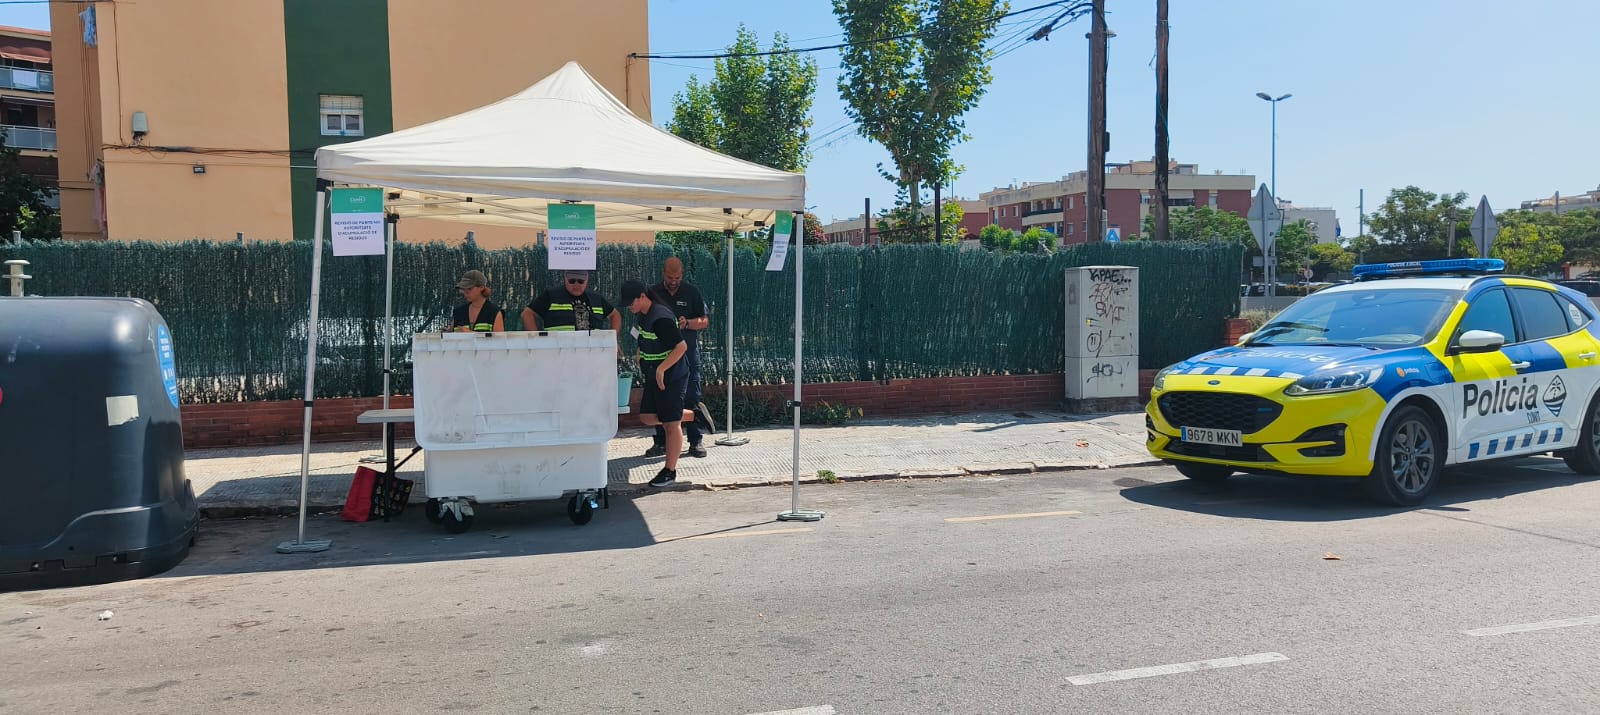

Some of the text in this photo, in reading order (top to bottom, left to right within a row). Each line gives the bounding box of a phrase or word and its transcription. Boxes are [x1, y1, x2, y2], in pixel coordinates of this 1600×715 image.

[1463, 377, 1538, 419] Policia
[1187, 429, 1239, 445] 9678 MKN
